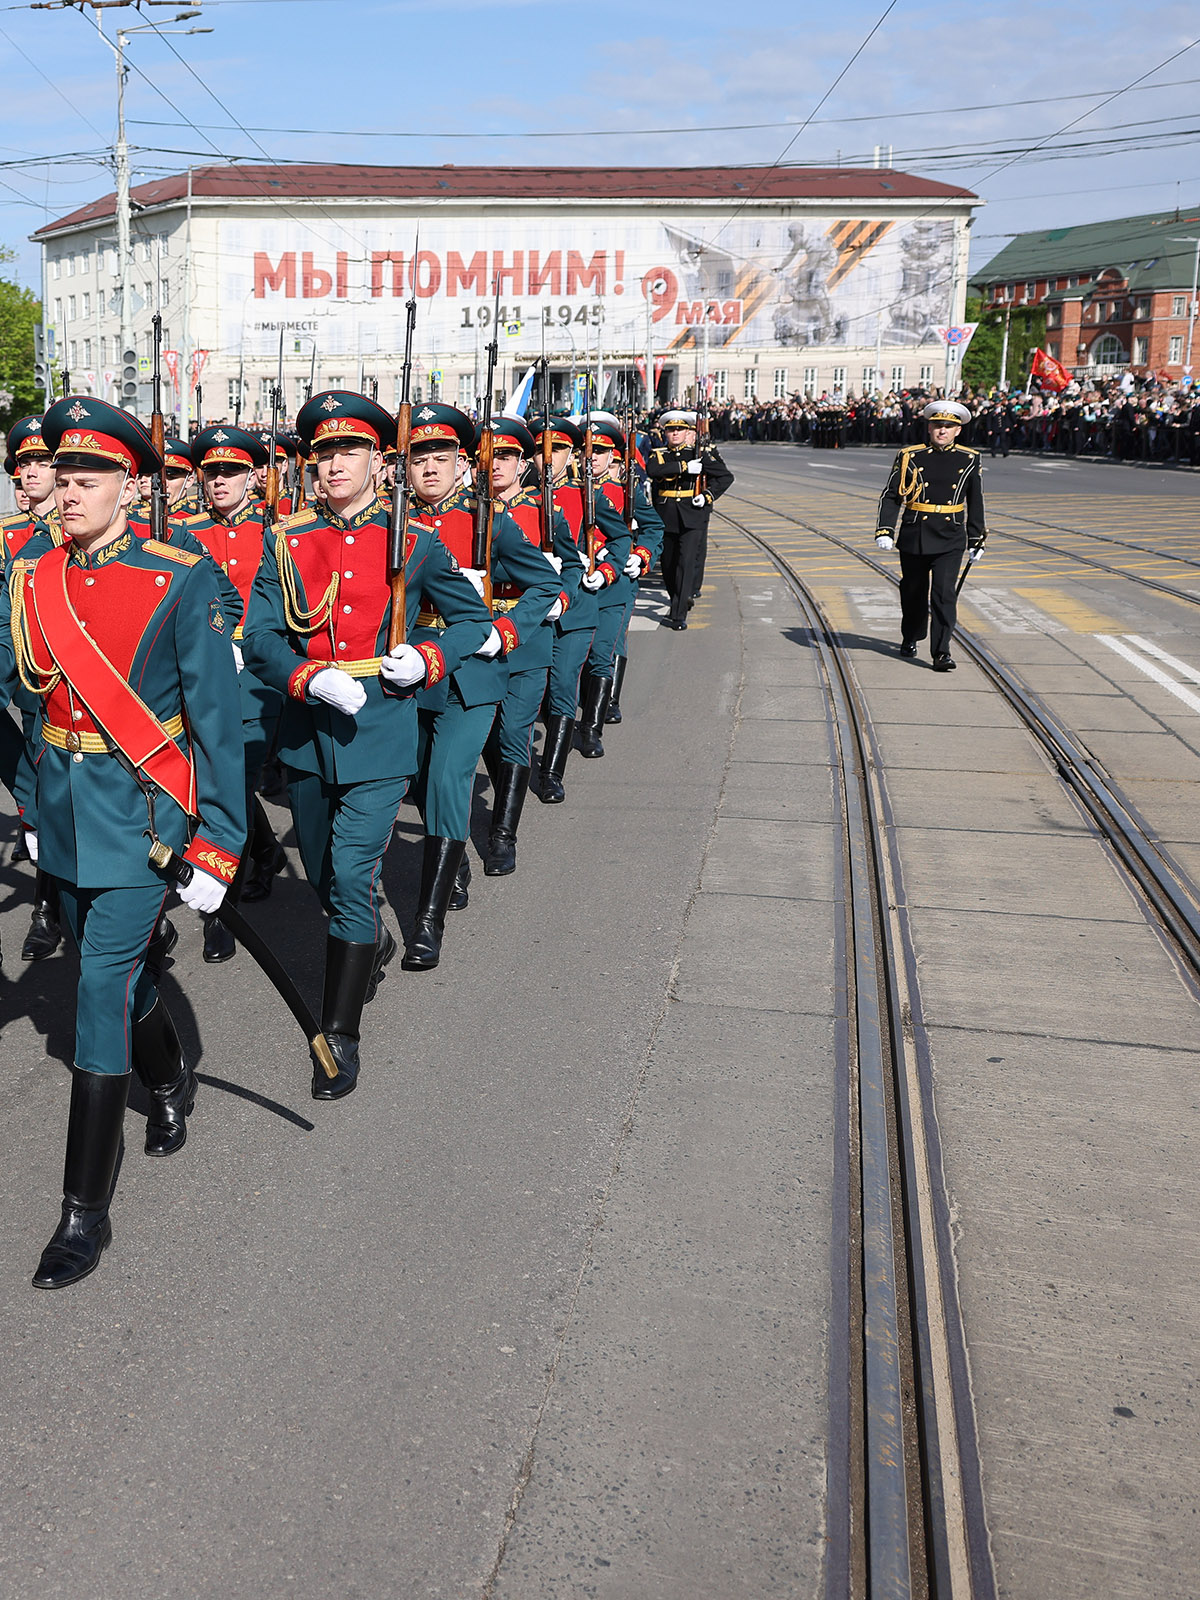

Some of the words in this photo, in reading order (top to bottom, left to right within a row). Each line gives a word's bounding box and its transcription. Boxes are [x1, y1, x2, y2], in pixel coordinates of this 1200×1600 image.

[253, 250, 348, 298] МЫ
[371, 249, 625, 298] ПОМНИМ!
[641, 266, 678, 323] 9
[675, 301, 741, 325] МАЯ
[254, 321, 318, 331] #МЫВМЕСТЕ
